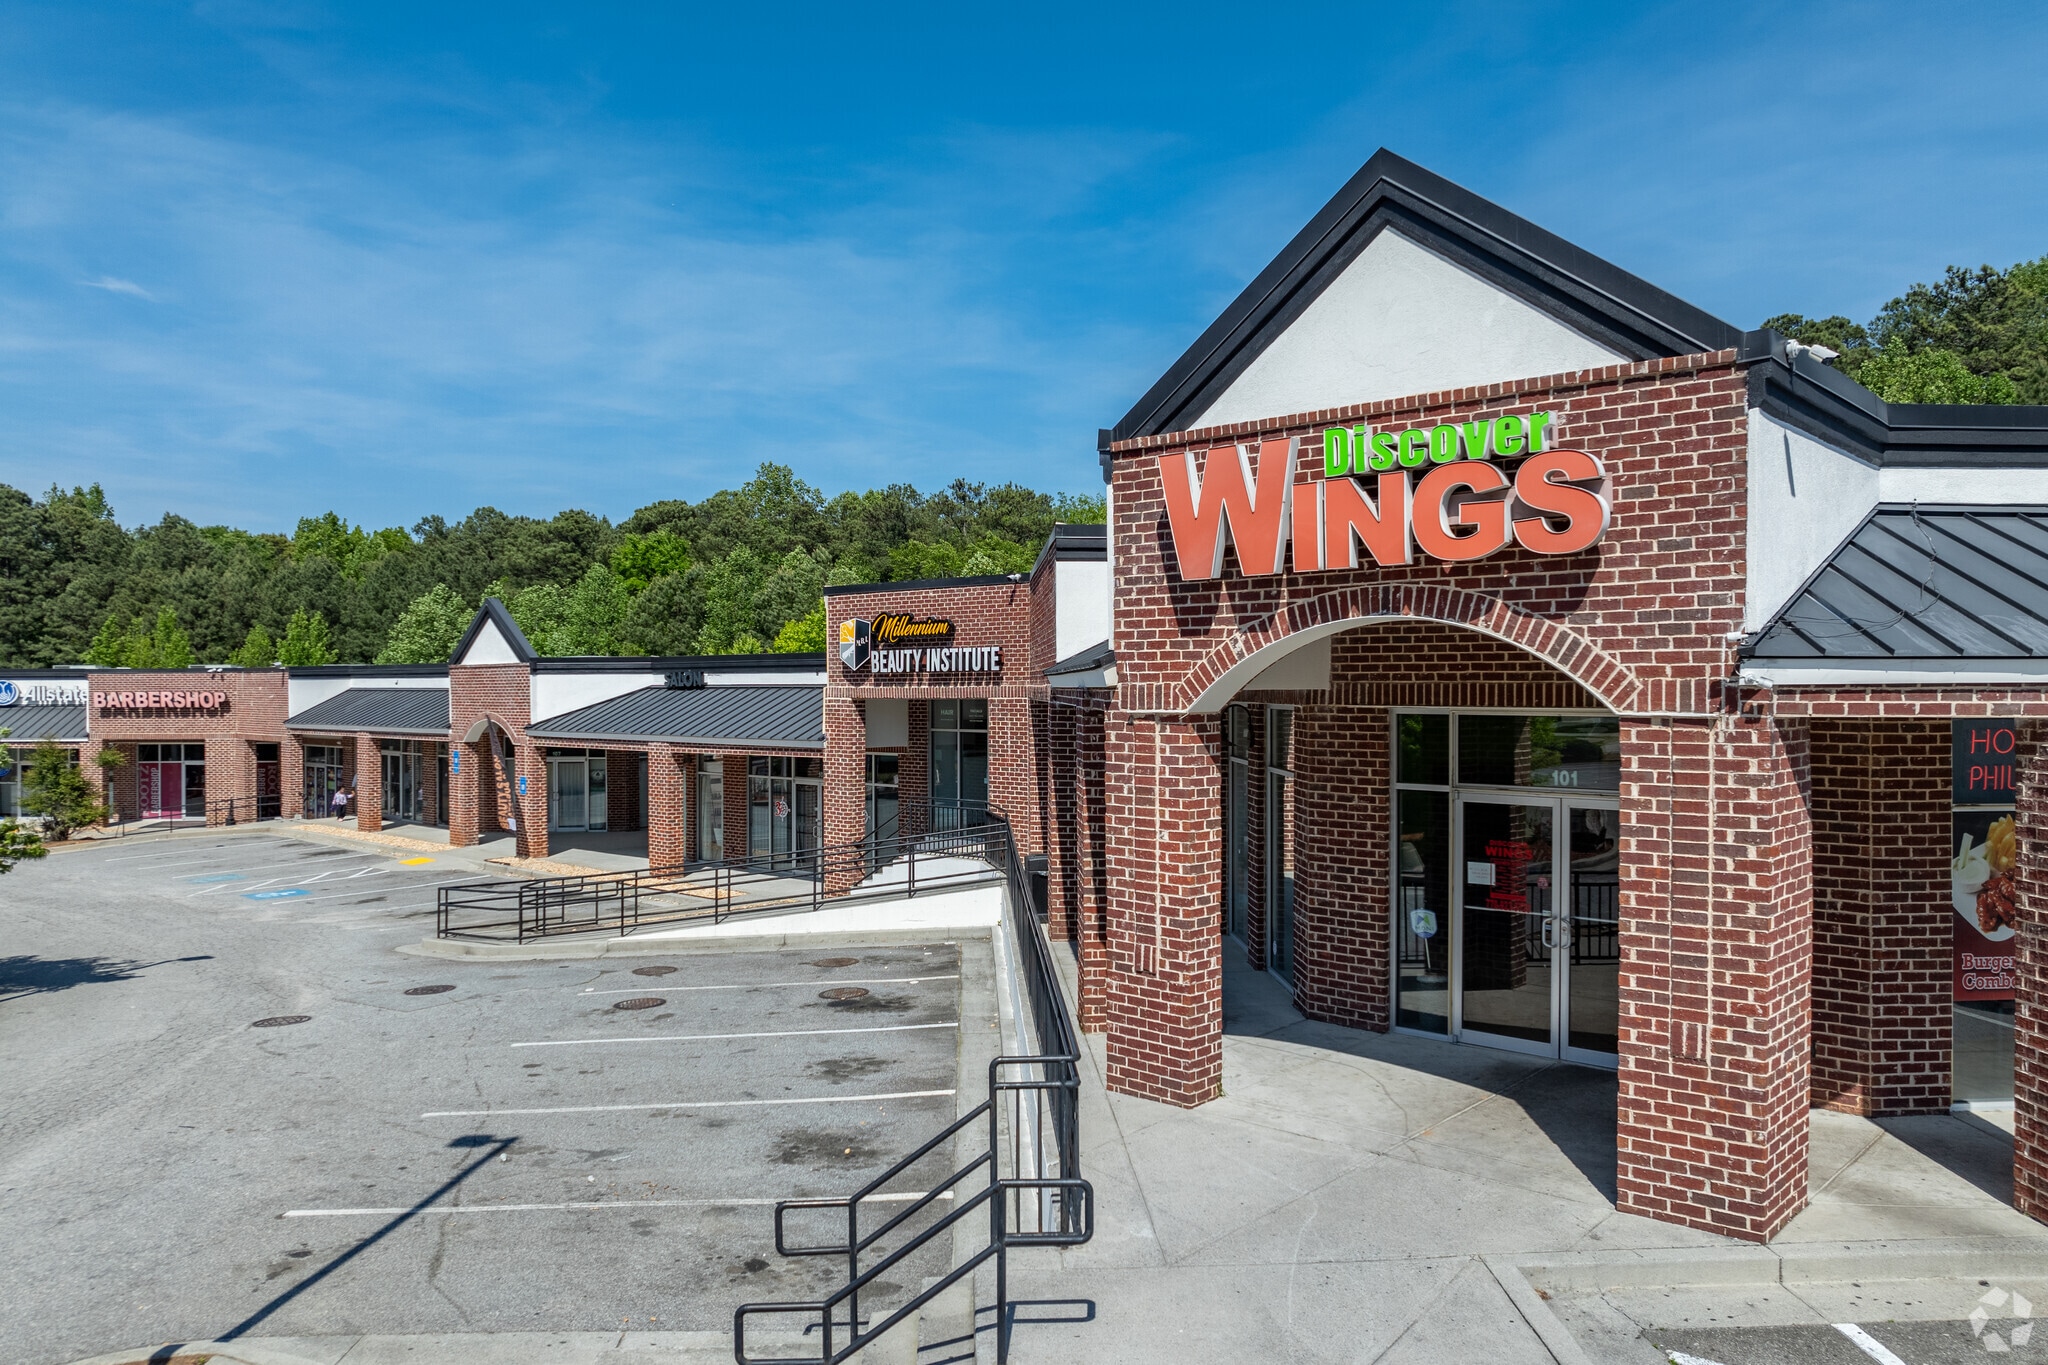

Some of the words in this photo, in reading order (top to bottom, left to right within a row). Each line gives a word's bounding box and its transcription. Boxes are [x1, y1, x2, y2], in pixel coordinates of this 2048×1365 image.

[1324, 409, 1556, 478] Discover
[1158, 437, 1611, 581] WINGS
[871, 613, 950, 643] Millennium
[871, 648, 922, 673] BEAUTY
[926, 646, 1000, 672] INSTITUTE
[22, 685, 88, 702] Allstate
[664, 671, 702, 687] SALON
[93, 691, 226, 708] BARBERSHOP
[493, 754, 503, 789] SALON
[1551, 770, 1578, 787] 101
[139, 765, 151, 817] ROOTZ
[150, 767, 159, 814] BARBERSHOP
[496, 791, 510, 830] BEAUTY
[1484, 845, 1534, 860] WINGS
